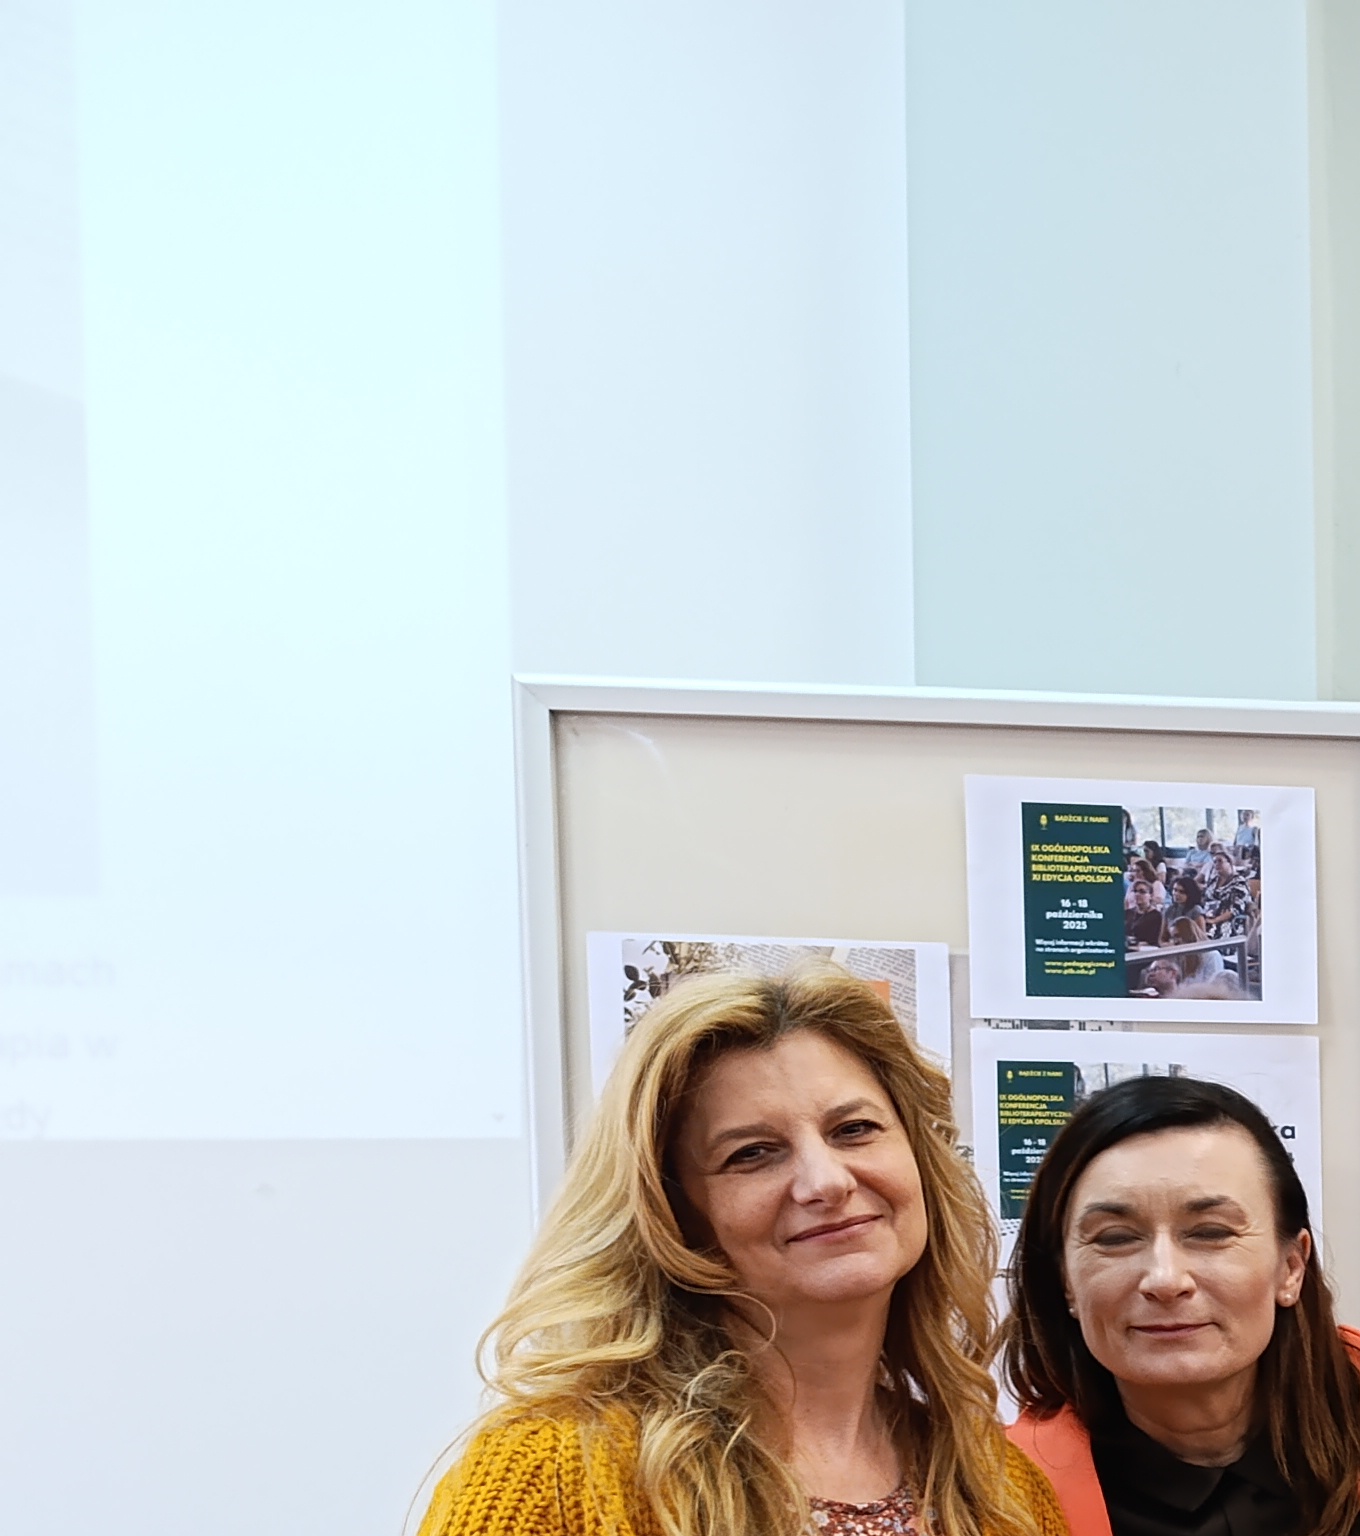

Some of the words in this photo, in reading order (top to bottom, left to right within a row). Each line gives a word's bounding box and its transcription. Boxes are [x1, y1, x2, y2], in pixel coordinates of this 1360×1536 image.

[1041, 842, 1110, 854] OGÓLNOPOLSKA
[1031, 854, 1090, 863] KONFERENCJA
[1042, 874, 1073, 882] EDYCJA
[1073, 875, 1114, 883] OPOLSKA
[1060, 899, 1071, 908] 16
[1077, 899, 1088, 908] 18
[1045, 910, 1103, 919] października
[1063, 920, 1087, 929] 2025
[0, 955, 116, 989] mach
[0, 1100, 53, 1138] dy
